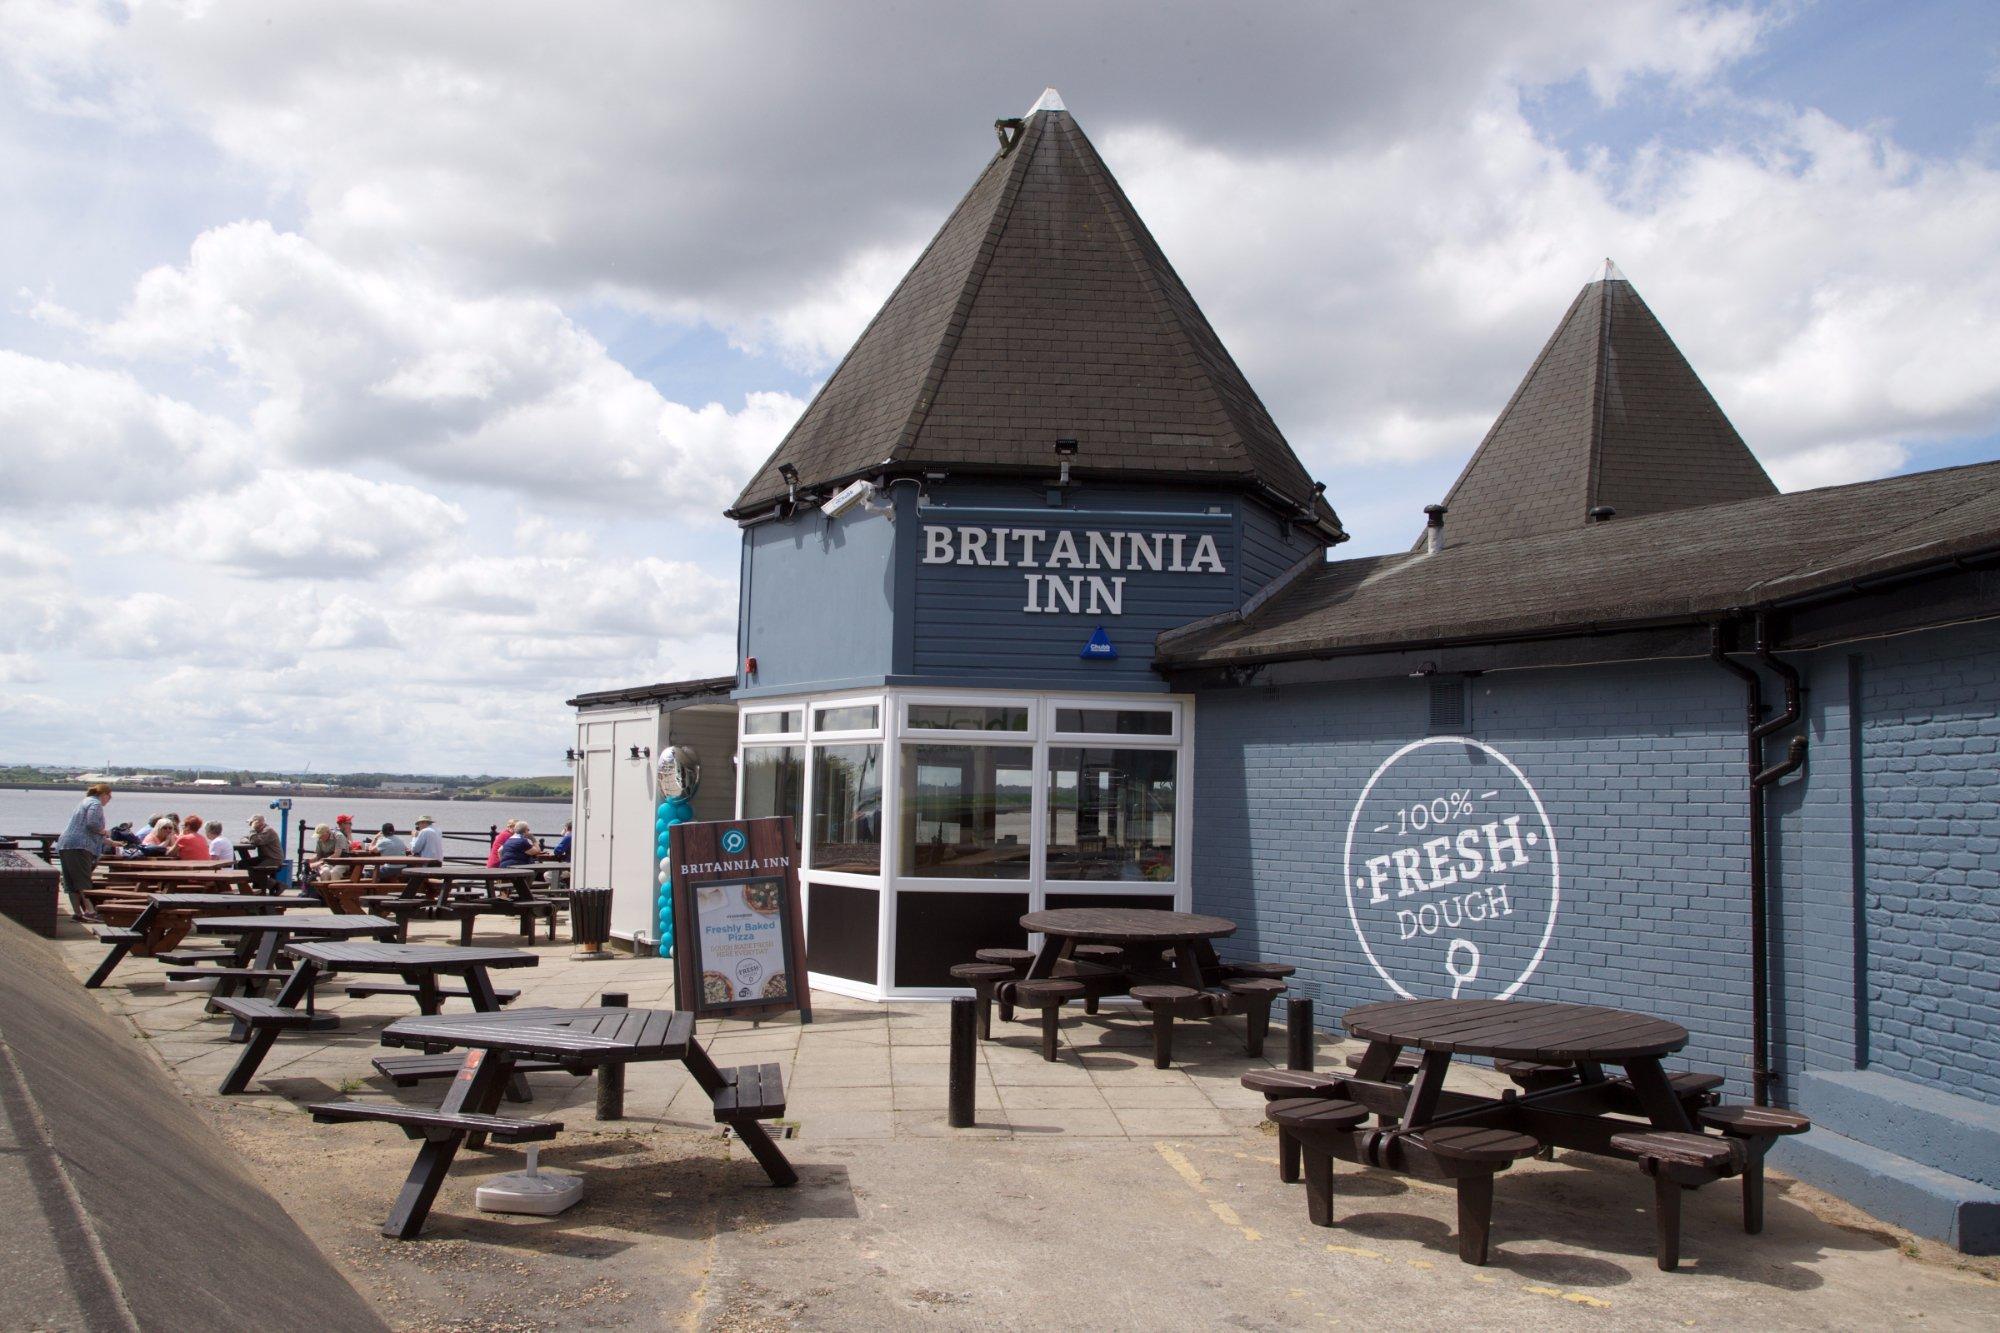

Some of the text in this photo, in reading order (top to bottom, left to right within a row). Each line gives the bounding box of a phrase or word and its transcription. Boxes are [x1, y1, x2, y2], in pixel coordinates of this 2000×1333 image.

[922, 525, 1226, 573] BRITANNIA
[1023, 574, 1127, 615] INN
[681, 856, 790, 875] BRITANNIA INN
[1365, 815, 1529, 905] FRESH
[705, 920, 776, 935] Freshly Baked
[1397, 883, 1514, 941] DOUGH
[728, 932, 755, 941] Pizza
